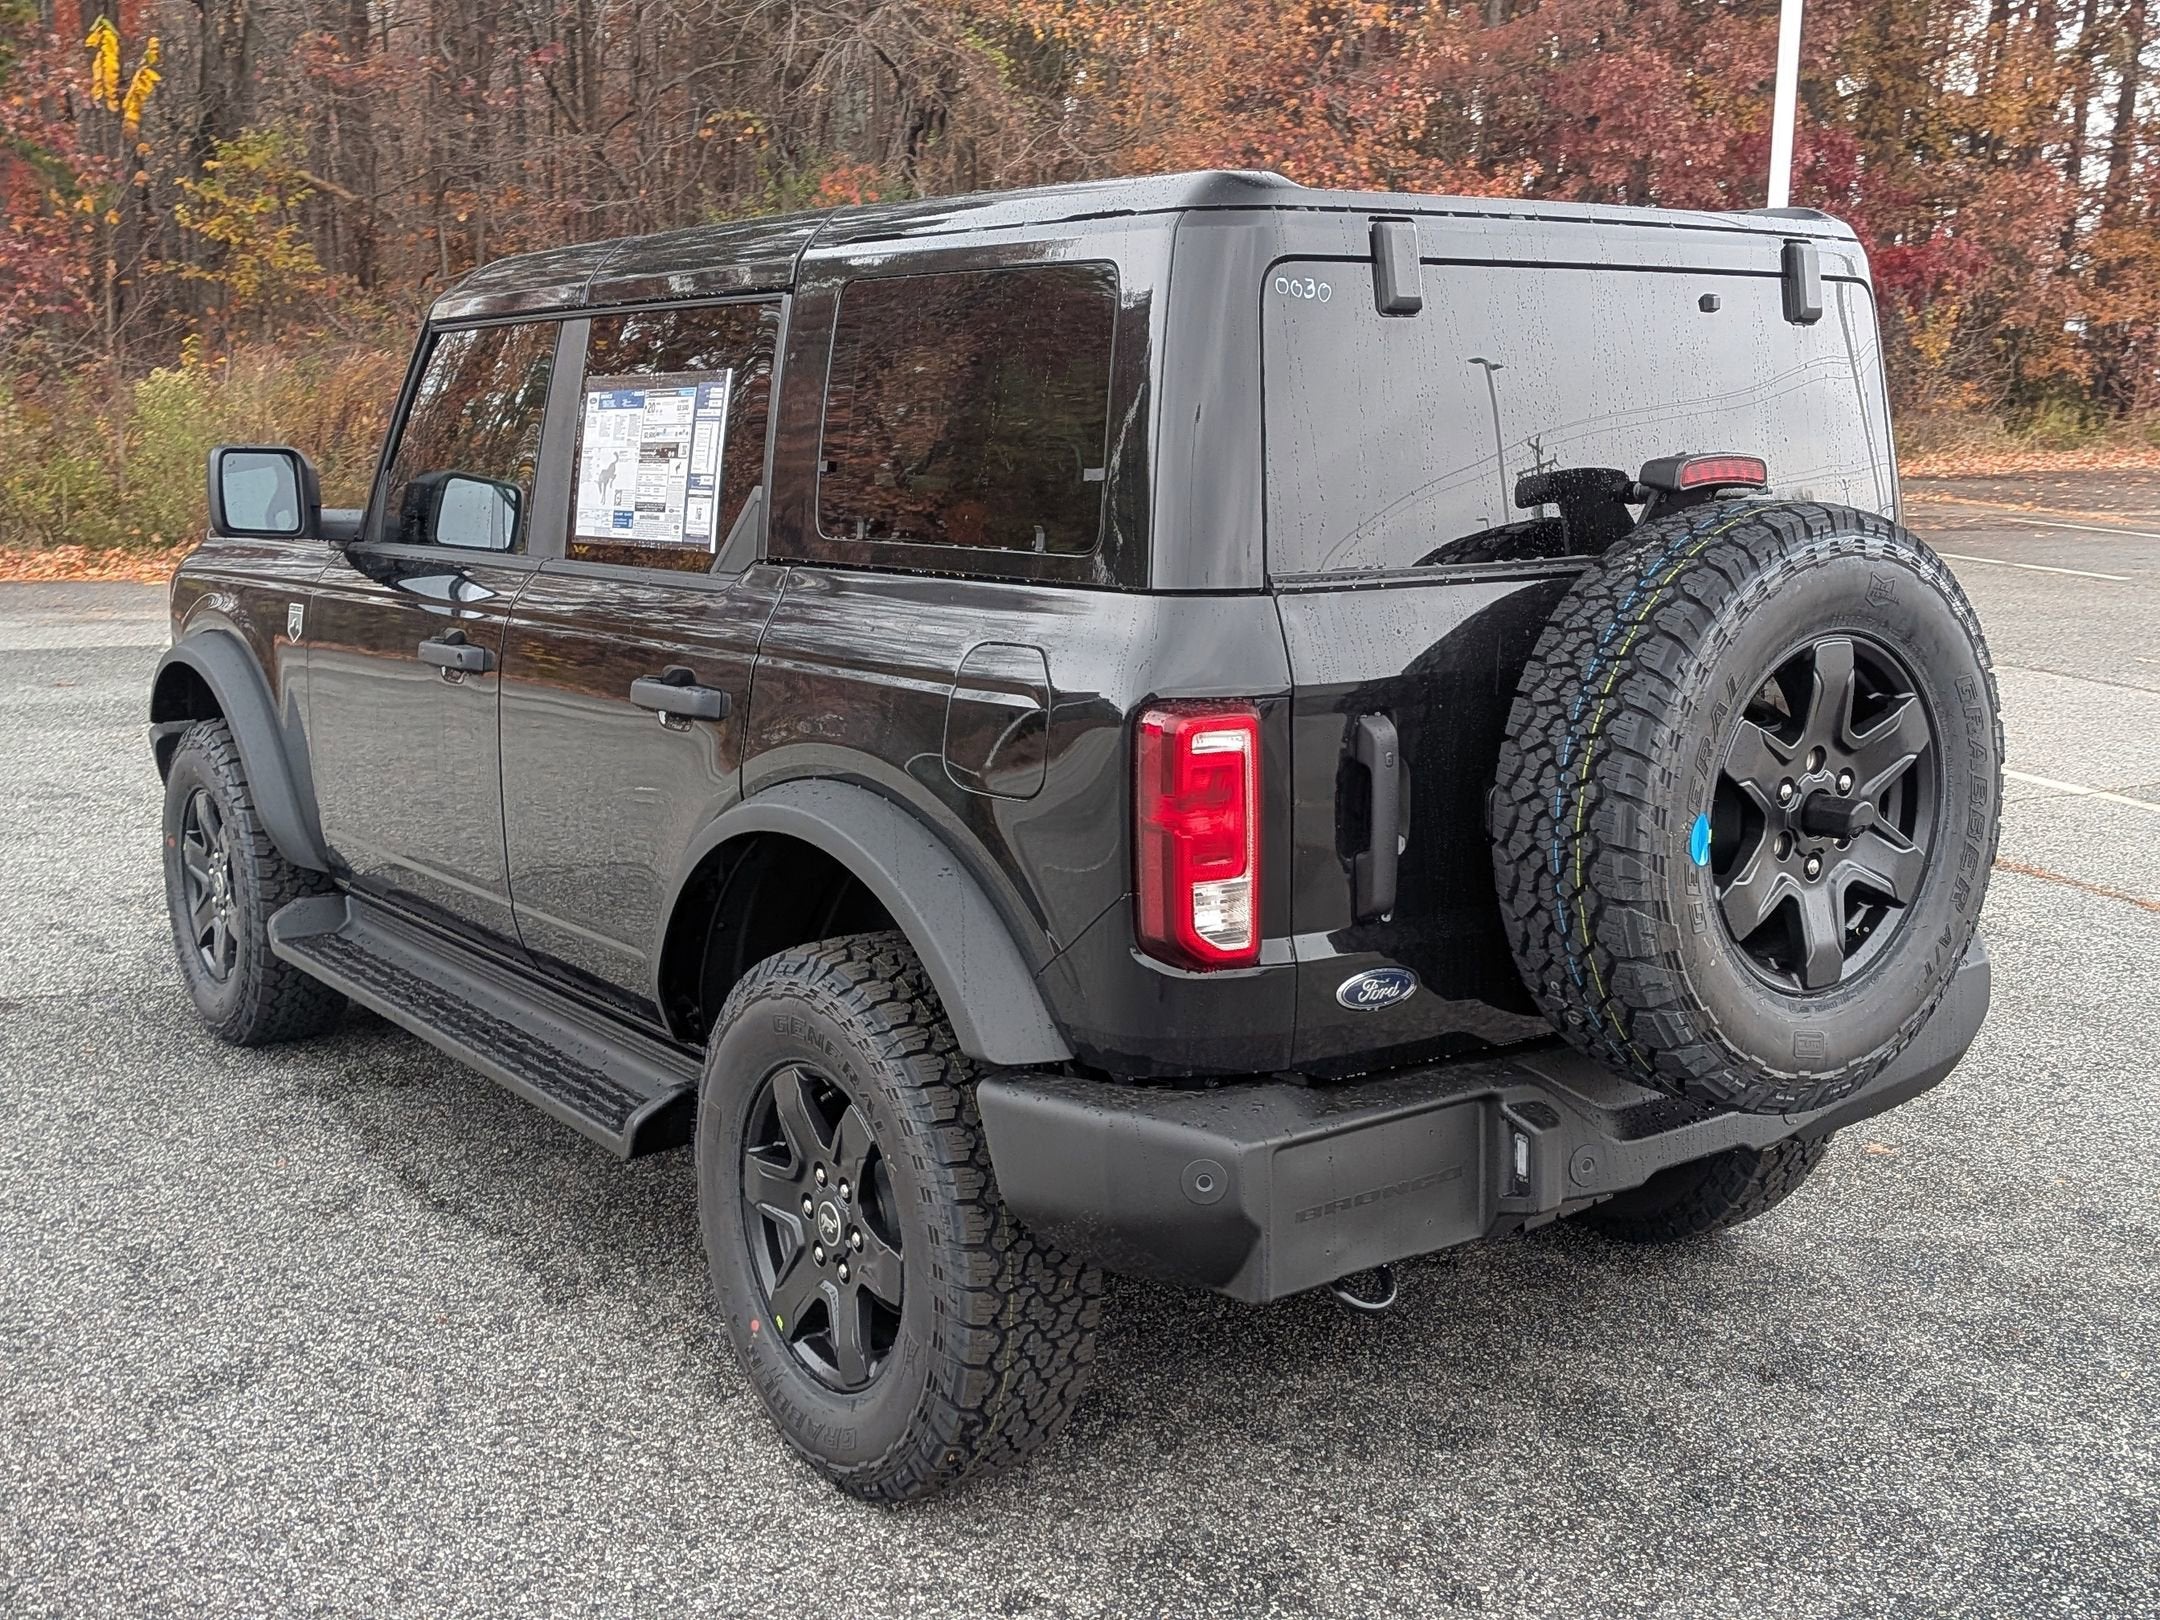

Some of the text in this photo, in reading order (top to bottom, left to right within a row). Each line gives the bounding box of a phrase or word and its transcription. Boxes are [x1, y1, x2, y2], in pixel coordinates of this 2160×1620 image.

[1684, 672, 1747, 935] GEERAL
[1952, 673, 1988, 914] GRABBER
[1358, 977, 1400, 1003] Ford
[772, 1014, 886, 1132] GENERAL
[1295, 1165, 1463, 1224] BRONCO
